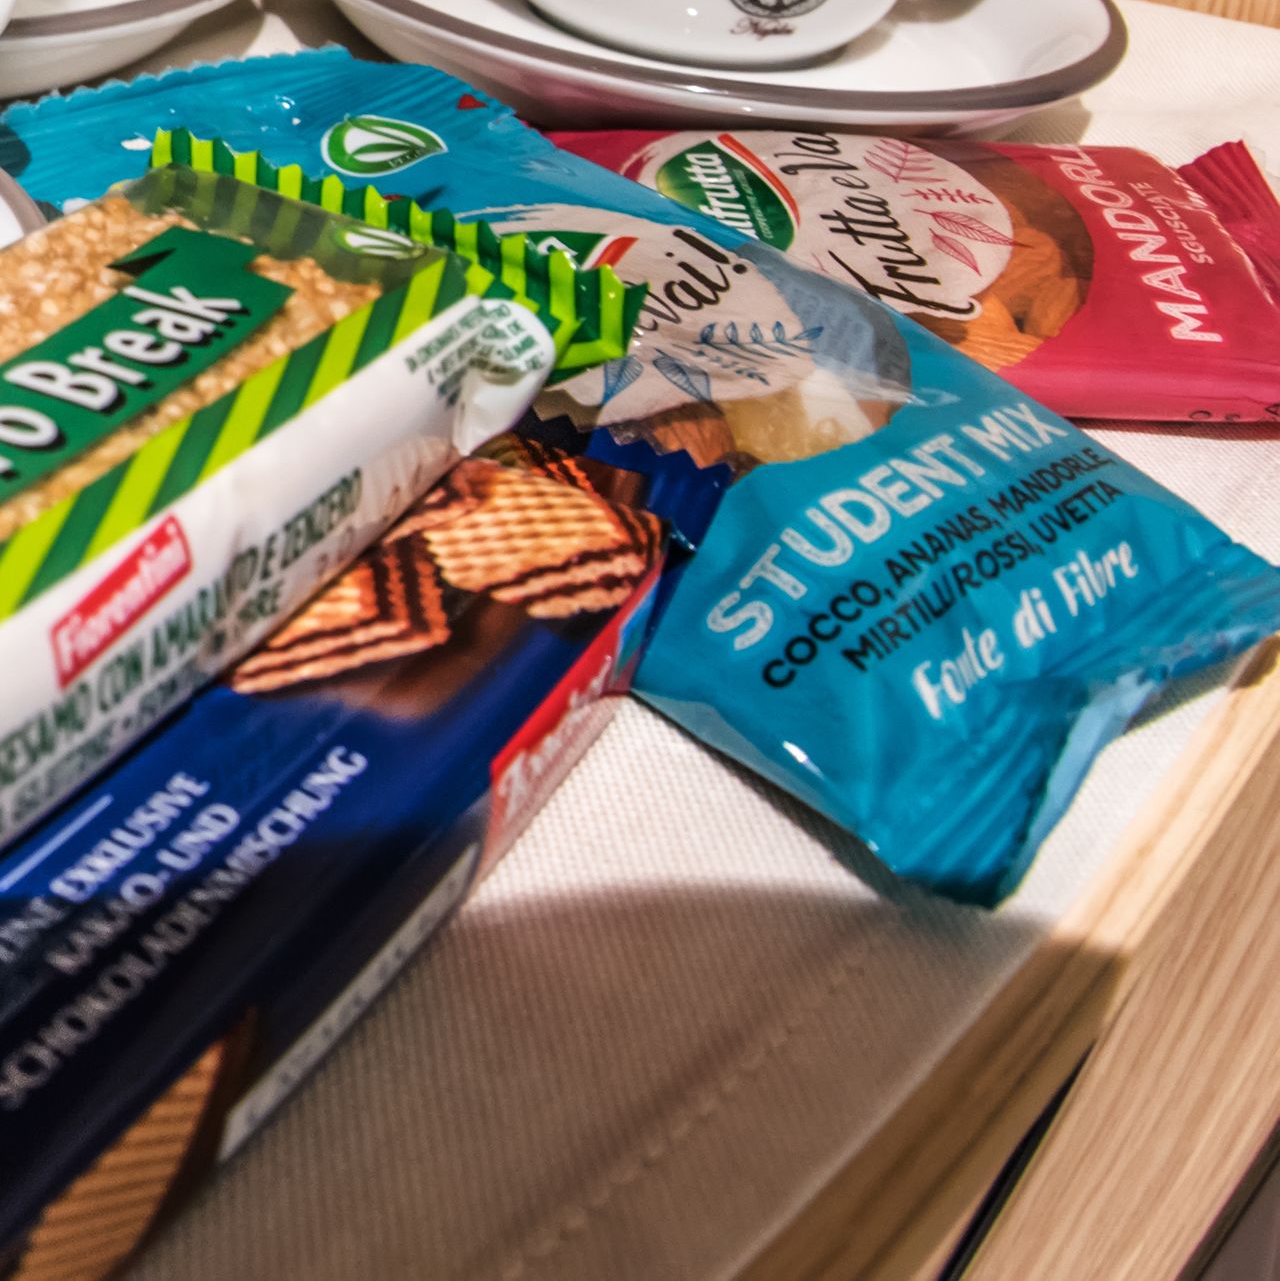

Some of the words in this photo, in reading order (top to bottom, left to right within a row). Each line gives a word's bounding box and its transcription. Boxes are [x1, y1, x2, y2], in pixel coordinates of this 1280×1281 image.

[818, 191, 980, 319] Frutta
[3, 286, 243, 412] Break
[706, 433, 969, 650] STUDENT
[960, 402, 1069, 473] MIX
[762, 580, 896, 689] COCCO,
[884, 505, 1002, 588] ANANAS,
[988, 447, 1117, 520] MANDORLE,
[1028, 479, 1125, 544] UVETTA
[912, 626, 1005, 720] Fonte
[1013, 587, 1057, 649] di
[1052, 540, 1139, 617] Fibre
[156, 803, 241, 873] UND
